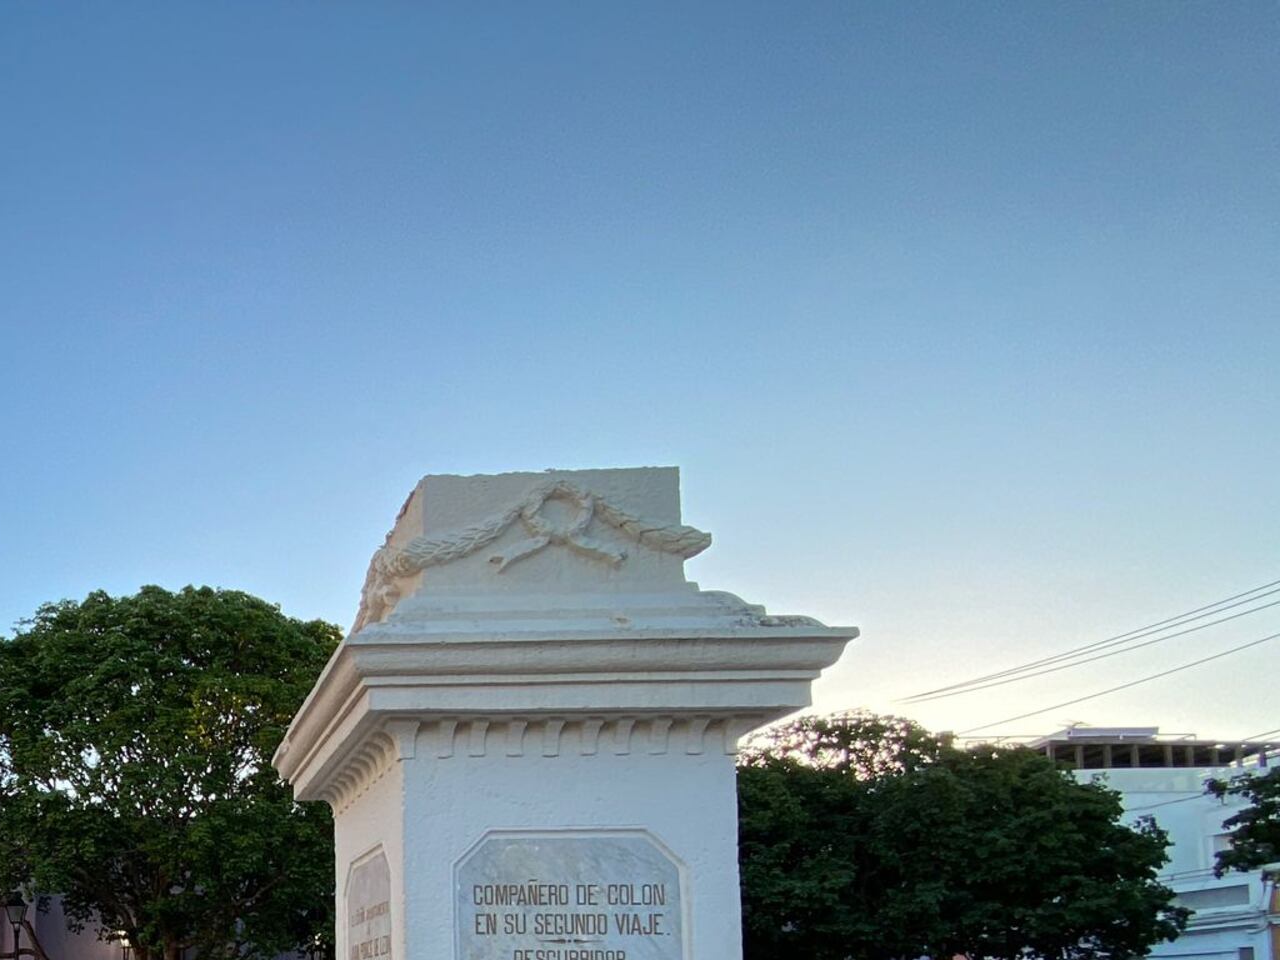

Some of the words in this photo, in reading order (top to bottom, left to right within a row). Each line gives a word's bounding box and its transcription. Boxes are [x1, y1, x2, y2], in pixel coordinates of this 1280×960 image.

[472, 879, 568, 905] COMPAÑERO
[576, 885, 598, 905] DE
[608, 885, 665, 905] COLON
[475, 914, 497, 935] EN
[504, 914, 526, 935] SU
[534, 914, 608, 935] SEGUNDO
[615, 914, 670, 935] VIAJE.
